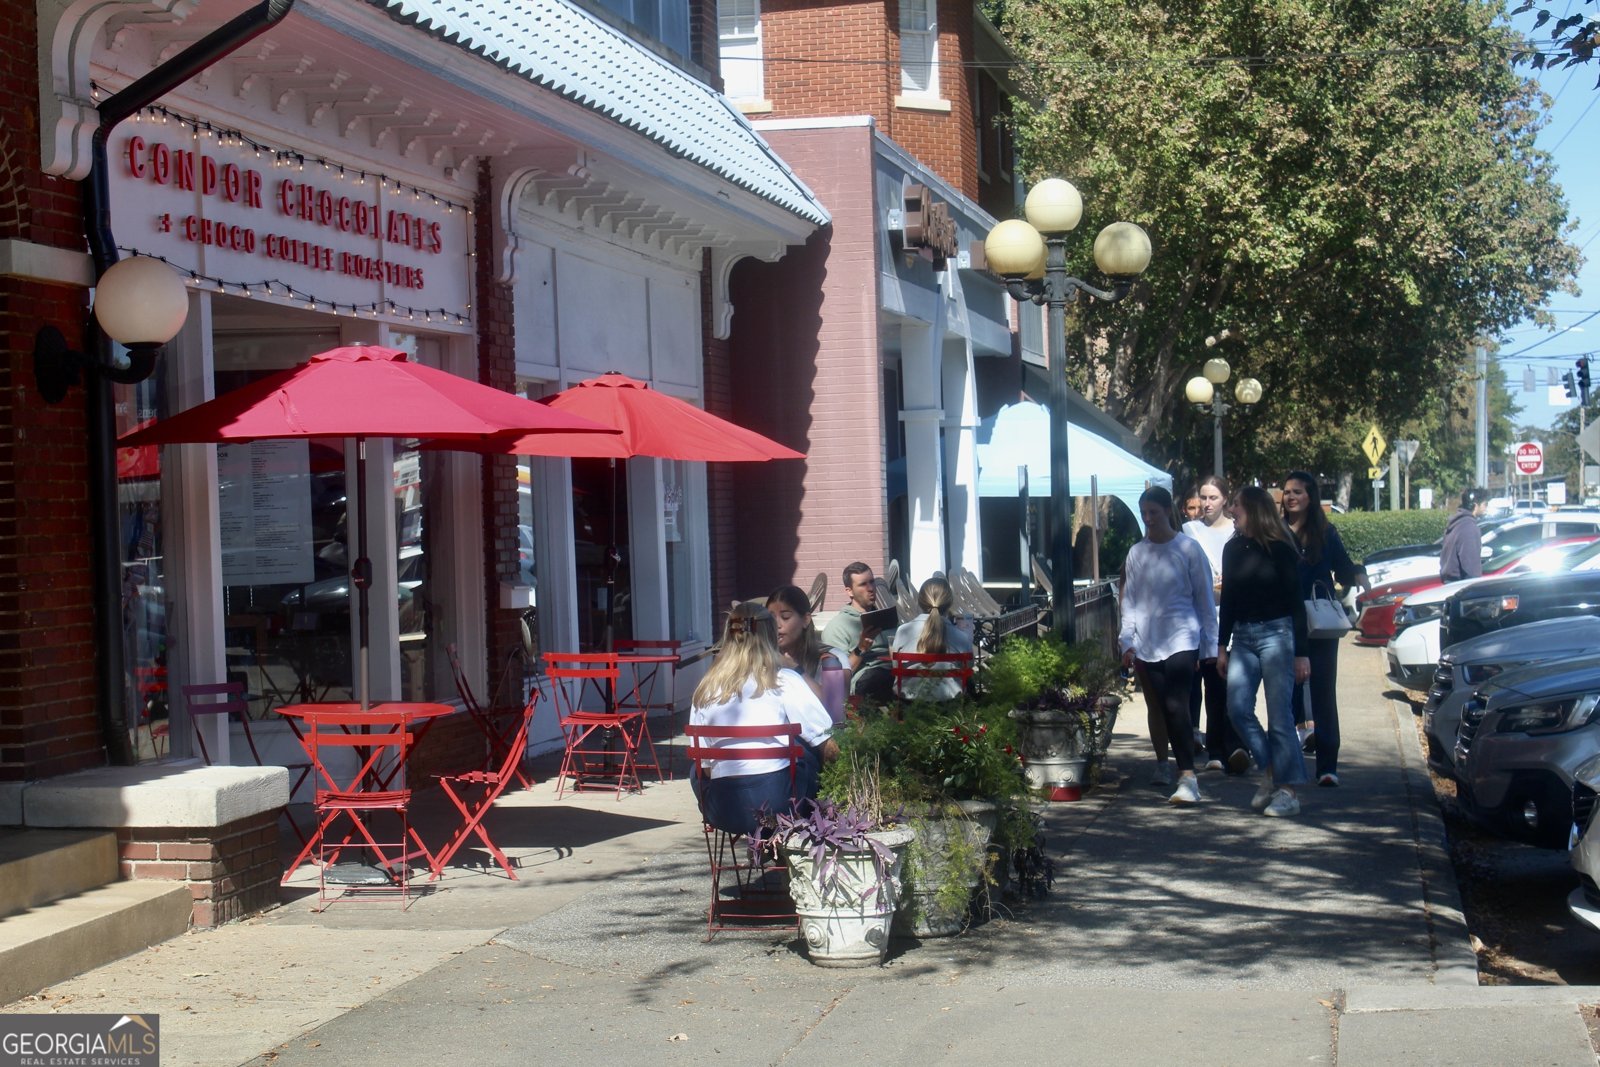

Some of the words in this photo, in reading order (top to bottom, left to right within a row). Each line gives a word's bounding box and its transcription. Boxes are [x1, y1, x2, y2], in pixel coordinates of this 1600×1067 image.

[129, 136, 263, 209] CONDOR
[281, 178, 443, 254] CHOCOLATES
[186, 215, 255, 254] CHOCO
[266, 233, 335, 272] COFFEE
[342, 252, 424, 290] ROASTERS
[1529, 447, 1538, 455] NOT
